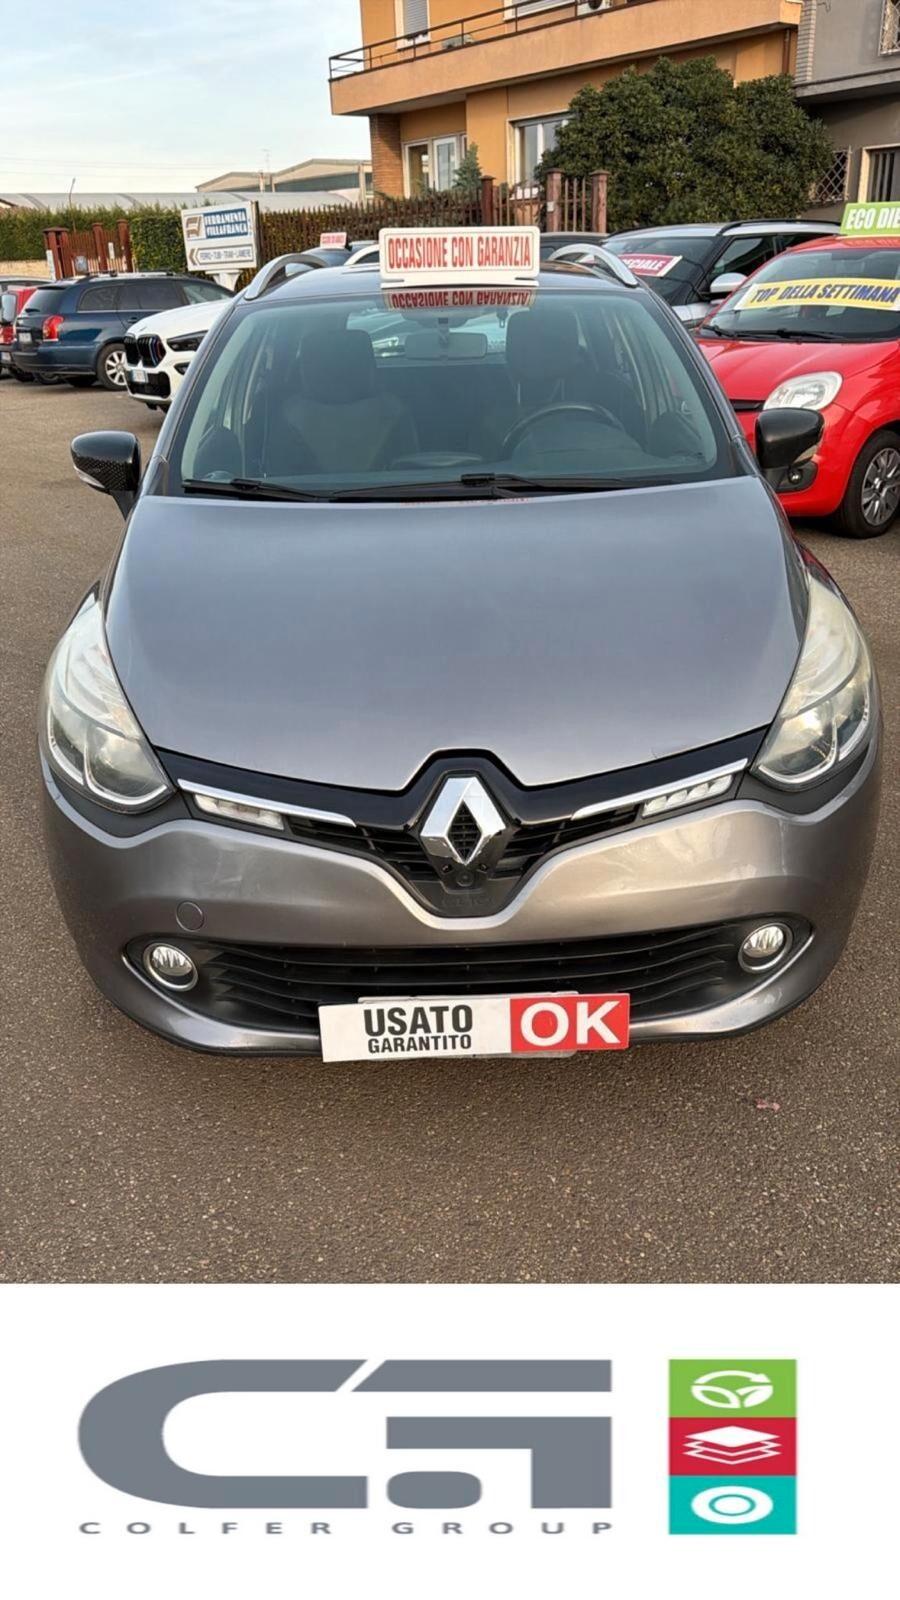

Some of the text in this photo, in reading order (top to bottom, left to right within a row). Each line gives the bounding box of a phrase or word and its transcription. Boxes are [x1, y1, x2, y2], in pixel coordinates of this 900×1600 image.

[205, 211, 246, 225] FERRAMENTA
[845, 208, 876, 230] ECO
[388, 235, 531, 268] OCCASIONE CON GARANZIA
[750, 284, 900, 303] TOP DELLA SETTIMANA
[363, 1004, 473, 1037] USATO
[520, 1001, 621, 1046] OK
[367, 1034, 472, 1054] GARANTITO
